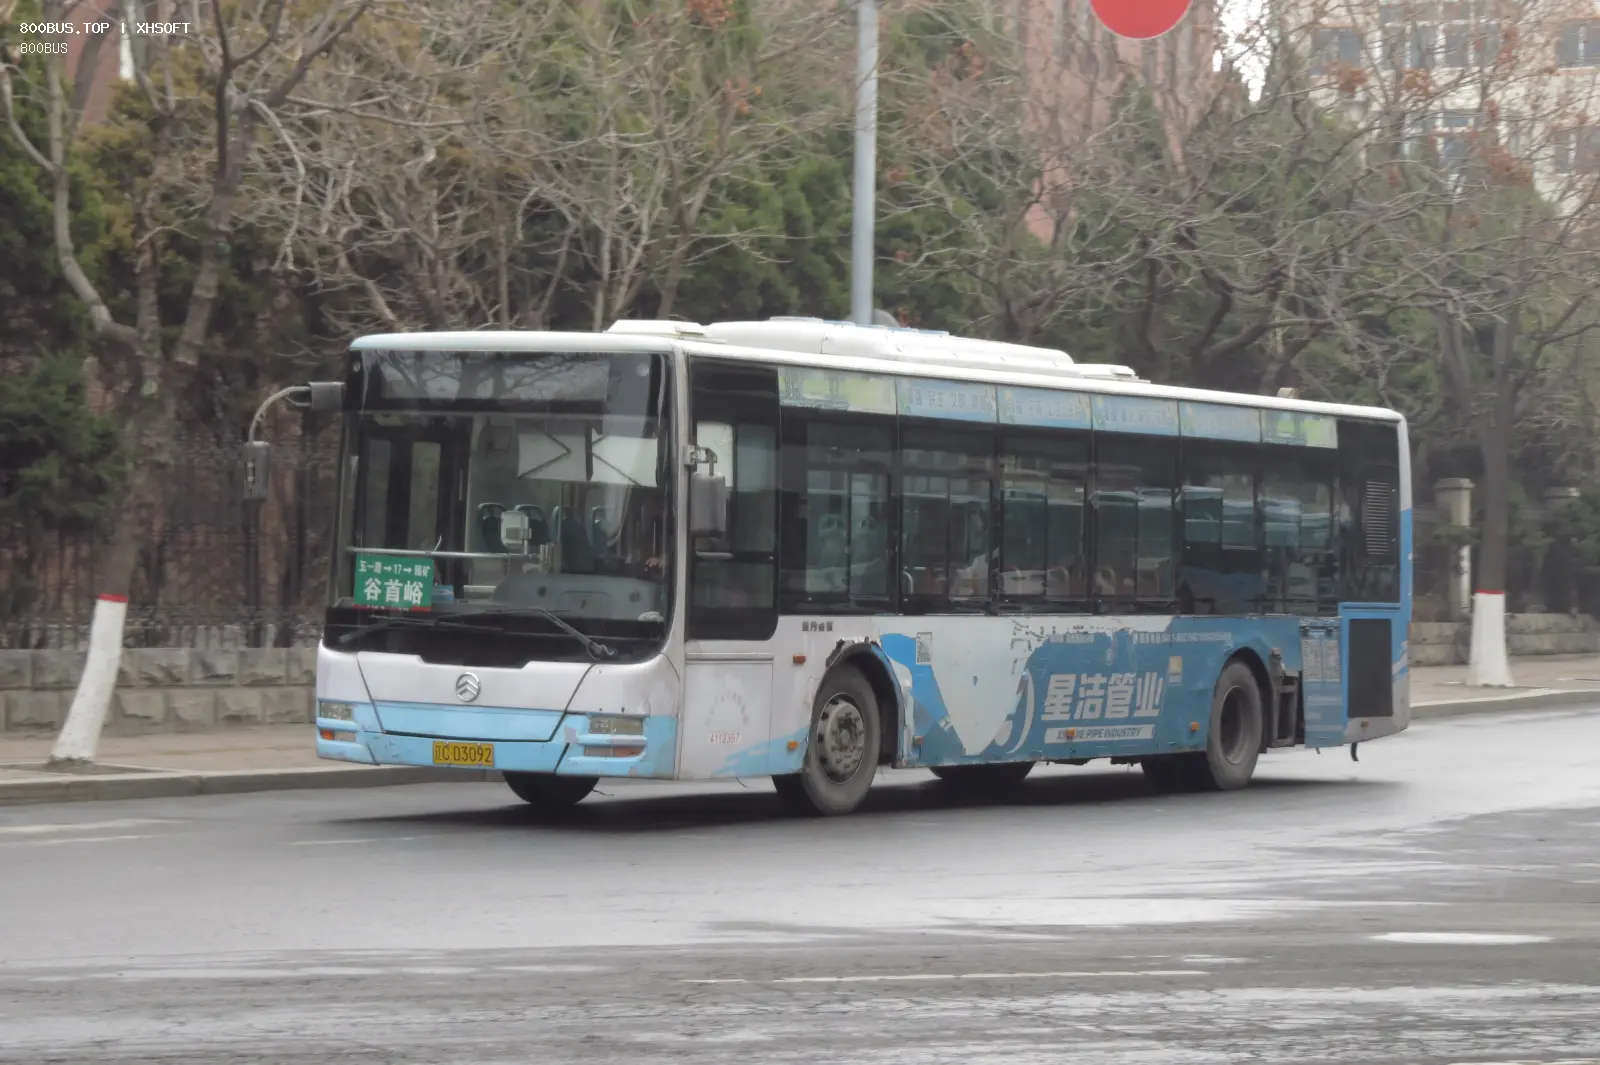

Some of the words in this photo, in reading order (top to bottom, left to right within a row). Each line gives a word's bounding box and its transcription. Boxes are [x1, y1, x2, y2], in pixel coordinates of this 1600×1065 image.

[364, 577, 424, 605] 谷首峪
[1041, 672, 1163, 720] 星洁管业
[1085, 728, 1104, 739] PIPE
[1103, 726, 1142, 738] INDUSTRY
